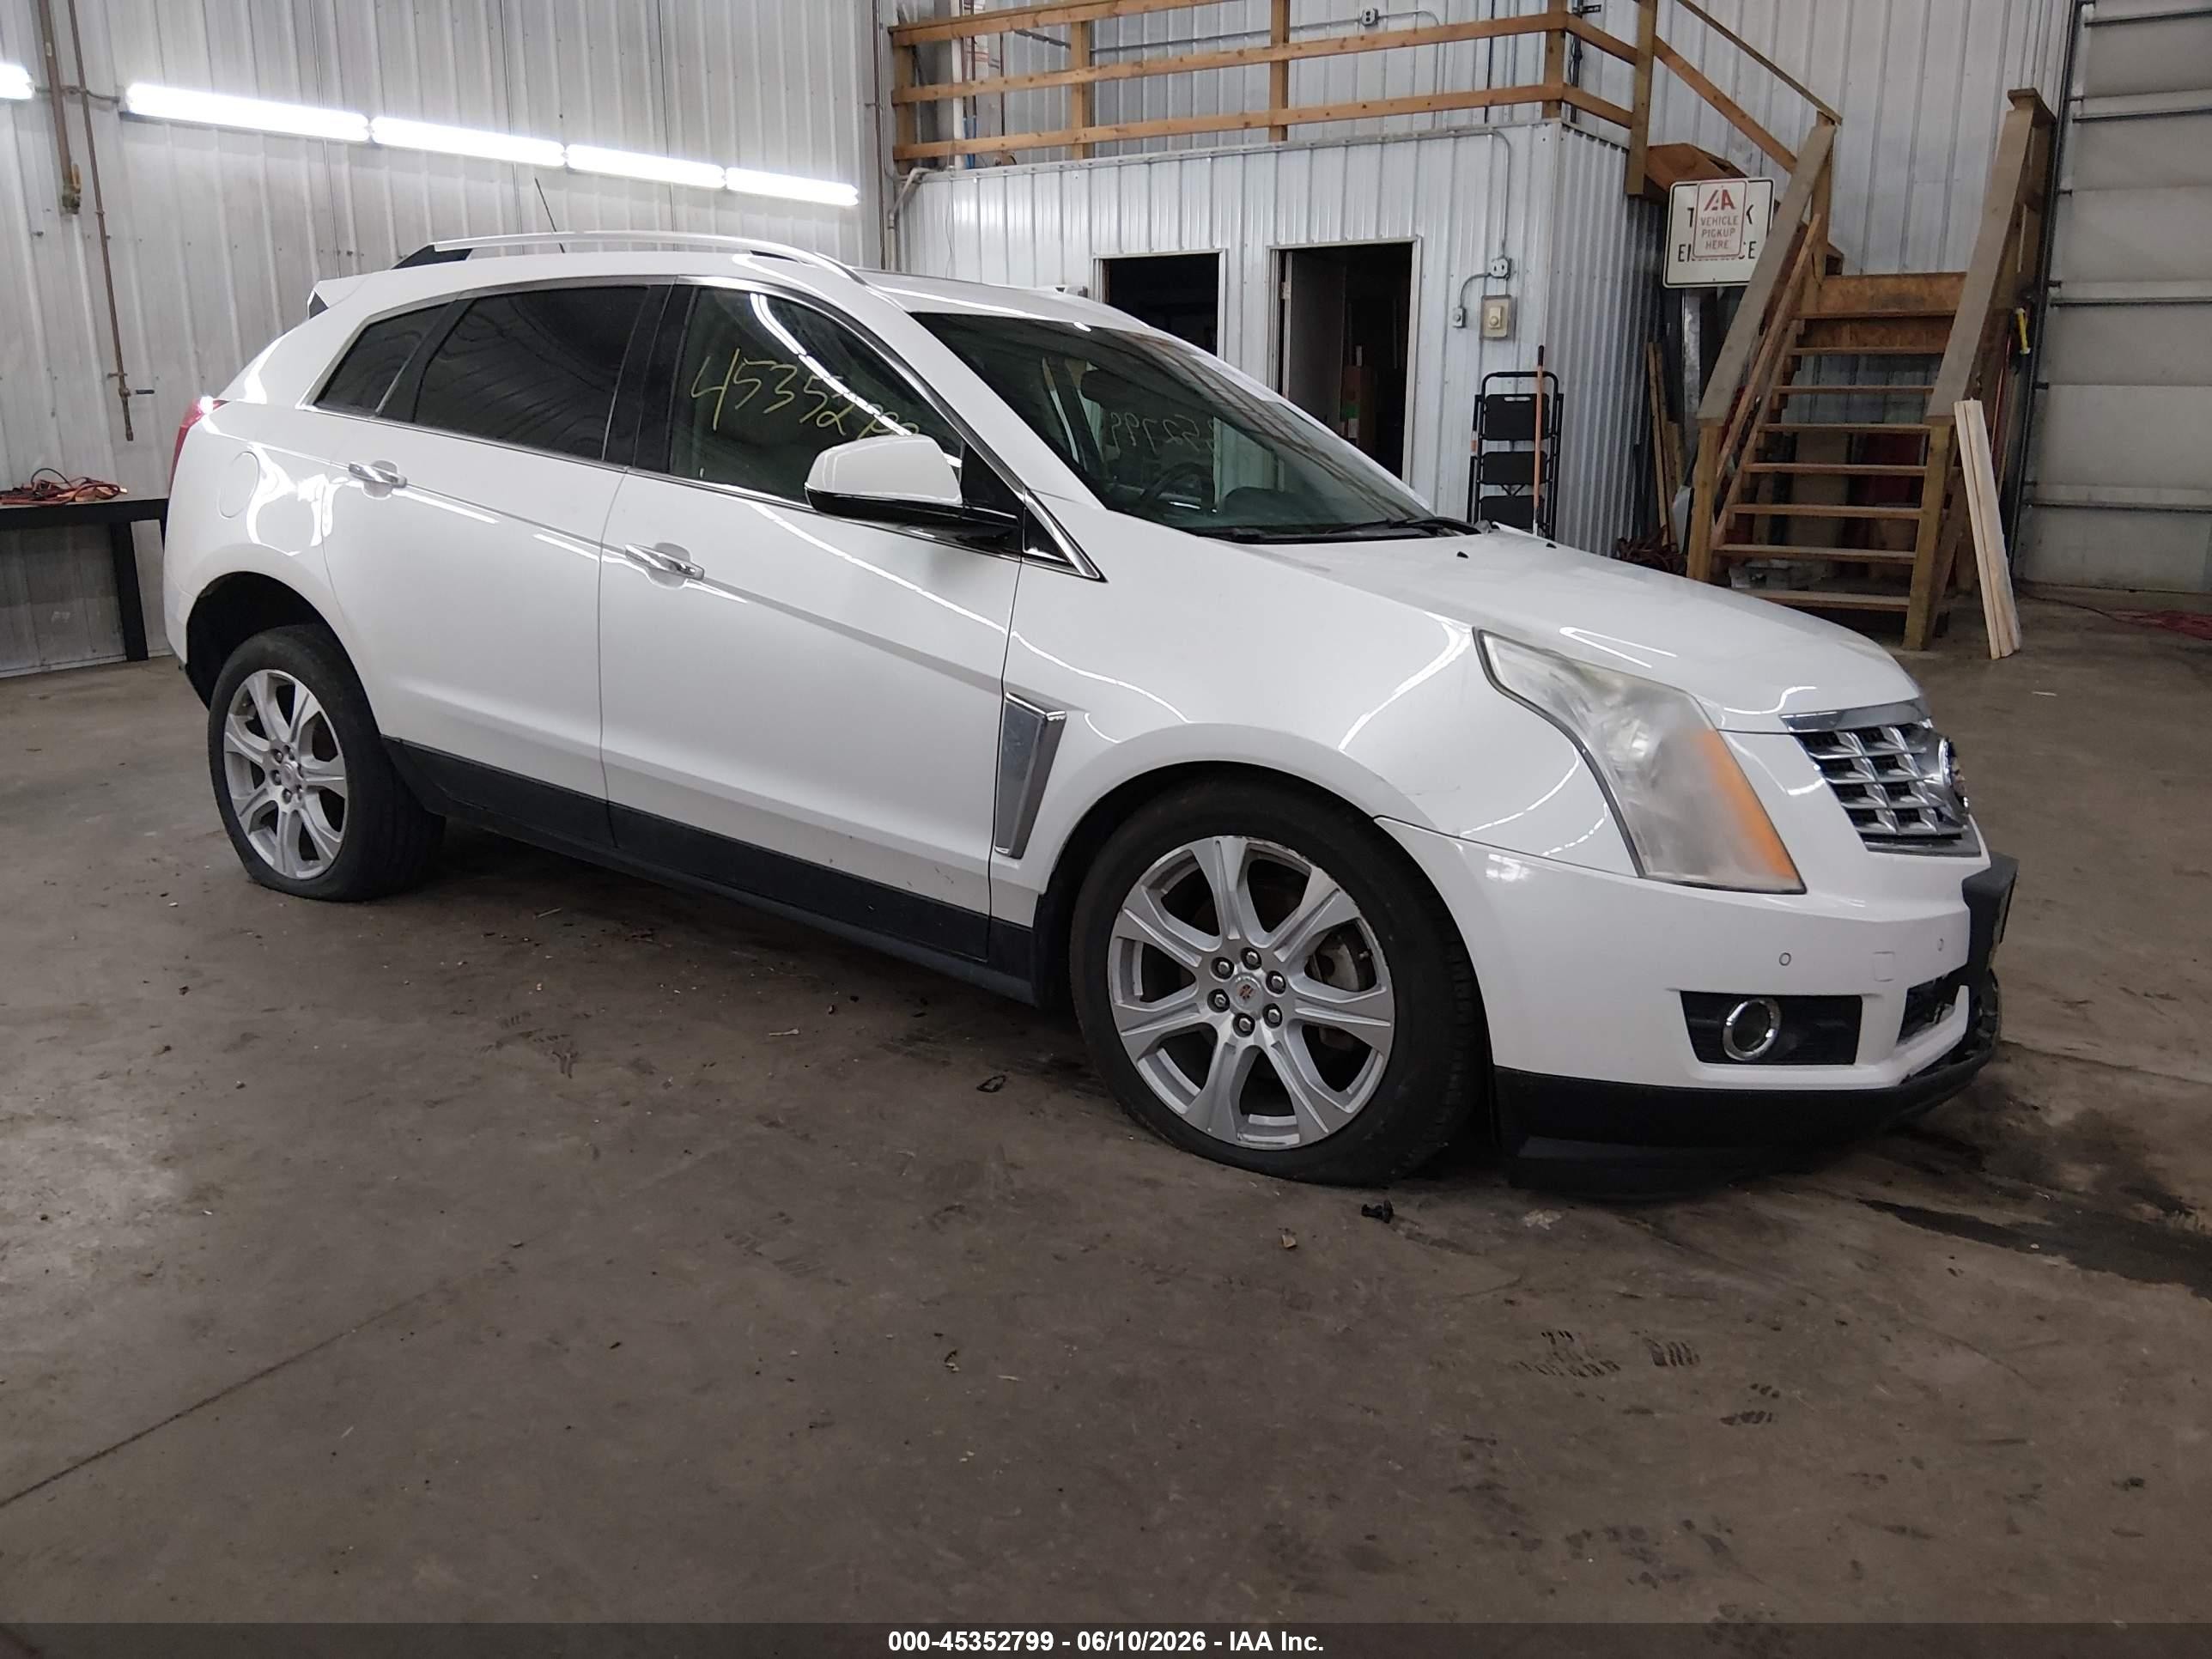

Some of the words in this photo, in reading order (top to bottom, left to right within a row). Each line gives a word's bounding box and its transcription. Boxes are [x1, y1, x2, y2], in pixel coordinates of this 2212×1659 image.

[1700, 216, 1739, 227] VEHICLE
[1701, 228, 1736, 239] PICKUP
[1705, 240, 1729, 250] HERE
[690, 347, 920, 440] 453527
